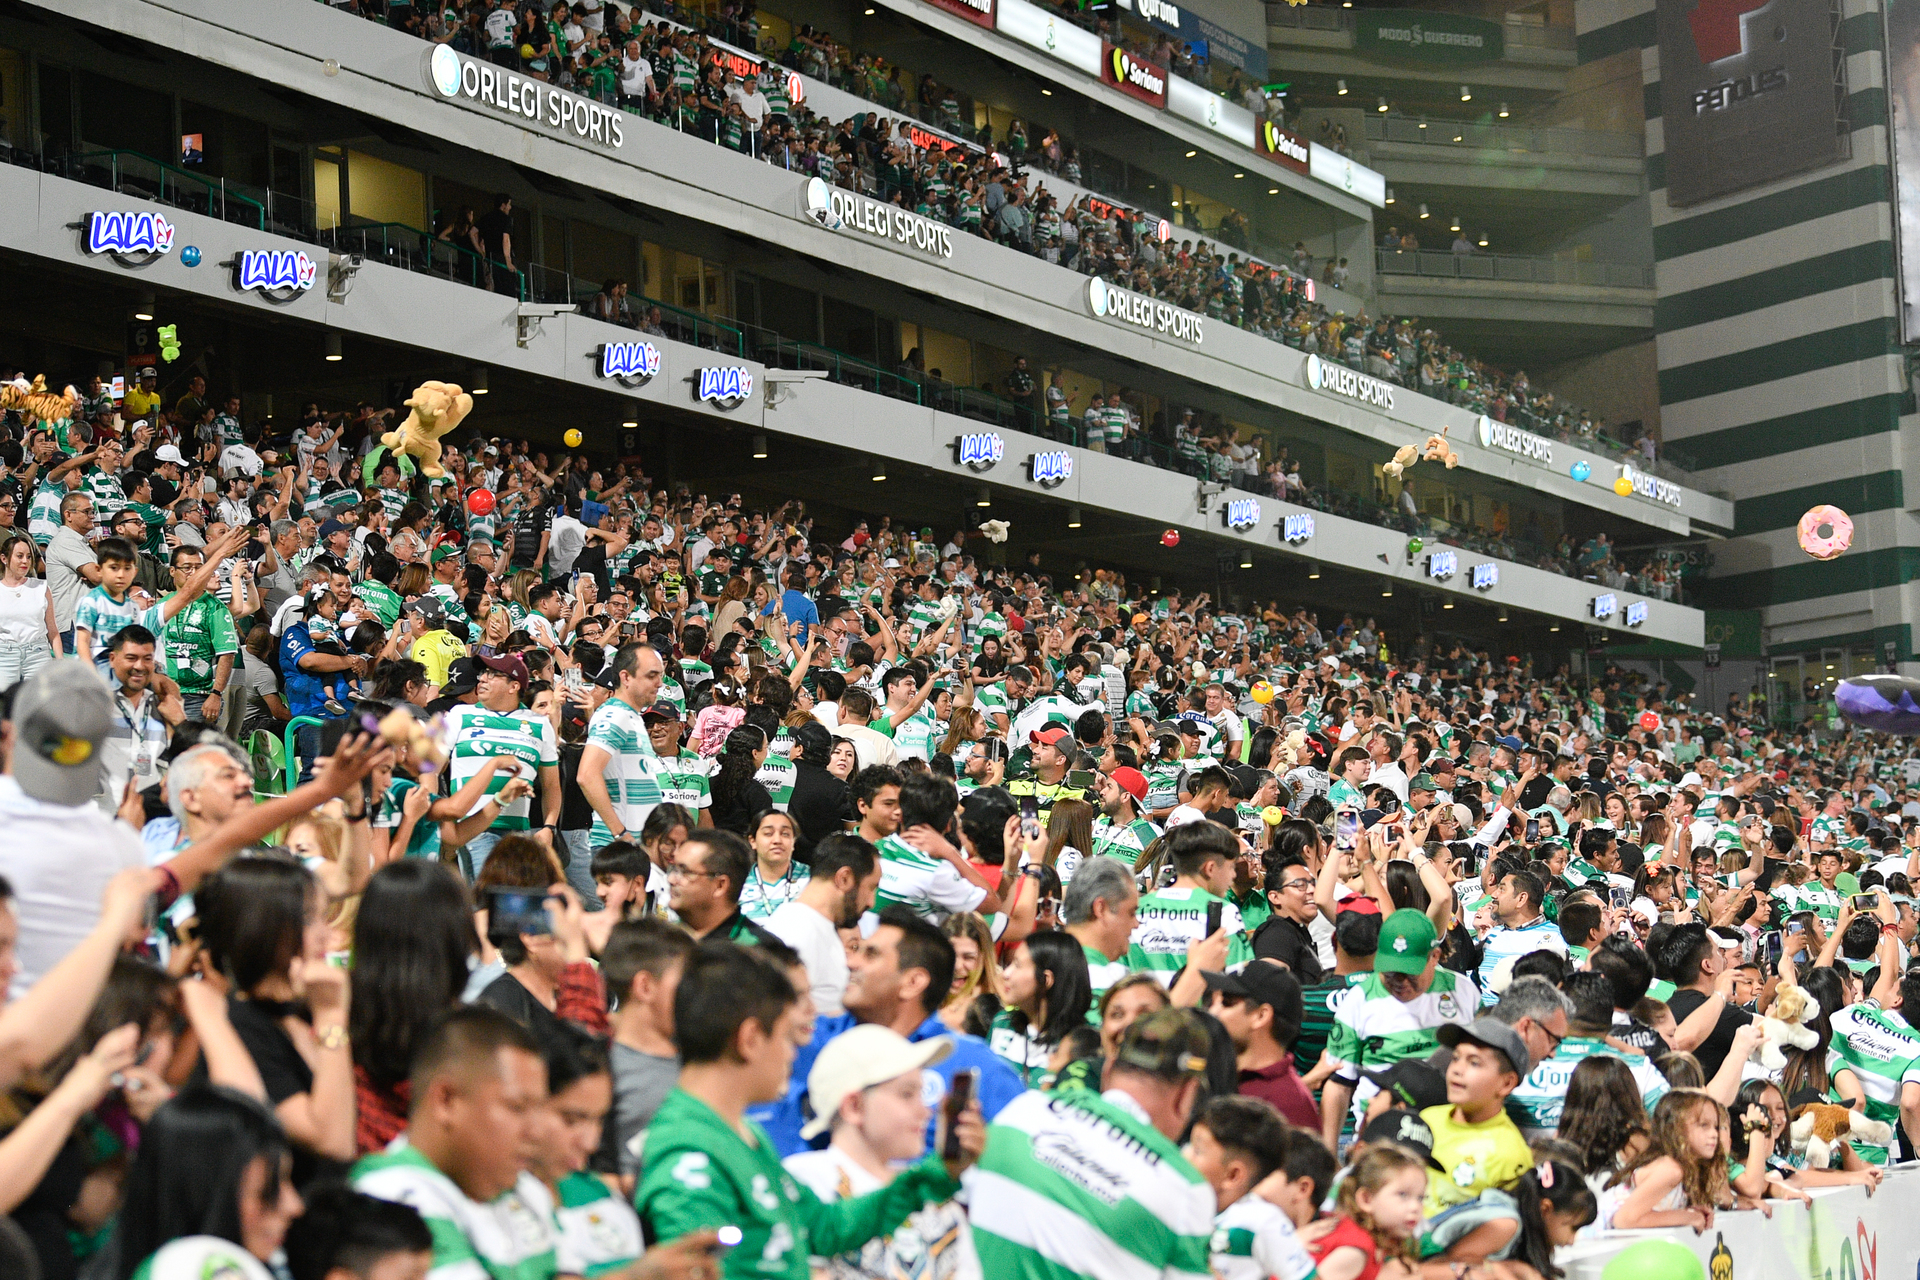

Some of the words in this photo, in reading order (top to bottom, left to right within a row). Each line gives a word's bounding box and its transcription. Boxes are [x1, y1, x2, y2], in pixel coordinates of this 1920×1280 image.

[1138, 0, 1180, 29] Corona
[1378, 27, 1411, 41] MODO
[1424, 31, 1483, 47] GUERRERO
[1130, 62, 1164, 95] Soriana
[1692, 66, 1789, 117] PEÑOLES
[462, 60, 541, 120] ORLEGI
[548, 90, 624, 148] SPORTS
[1278, 133, 1308, 163] Soriana
[92, 213, 156, 251] LALA
[830, 191, 891, 238] ORLEGI
[895, 211, 952, 258] SPORTS
[237, 252, 299, 288] LALA
[1107, 288, 1155, 329] ORLEGI
[1156, 304, 1204, 345] SPORTS
[135, 328, 148, 347] 6
[605, 344, 648, 375] LALA
[701, 368, 741, 400] LALA
[1320, 363, 1358, 398] ORLEGI
[1358, 373, 1394, 410] SPORTS
[624, 433, 635, 449] 8
[960, 434, 994, 463] LALA
[1490, 424, 1524, 453] ORLEGI
[1523, 433, 1552, 463] SPORTS
[1033, 454, 1067, 480] LALA
[1228, 502, 1254, 526] LALA
[1284, 516, 1308, 540] LALA
[1430, 552, 1450, 577] LALA
[1474, 564, 1492, 588] LALA
[352, 584, 389, 601] Corona
[495, 745, 537, 763] Soriana
[1851, 1008, 1913, 1045] Corona
[1561, 1043, 1590, 1054] CHARLY
[1847, 1031, 1896, 1054] Caliente
[1848, 1041, 1891, 1063] caliente.mx
[1048, 1095, 1162, 1167] Corona
